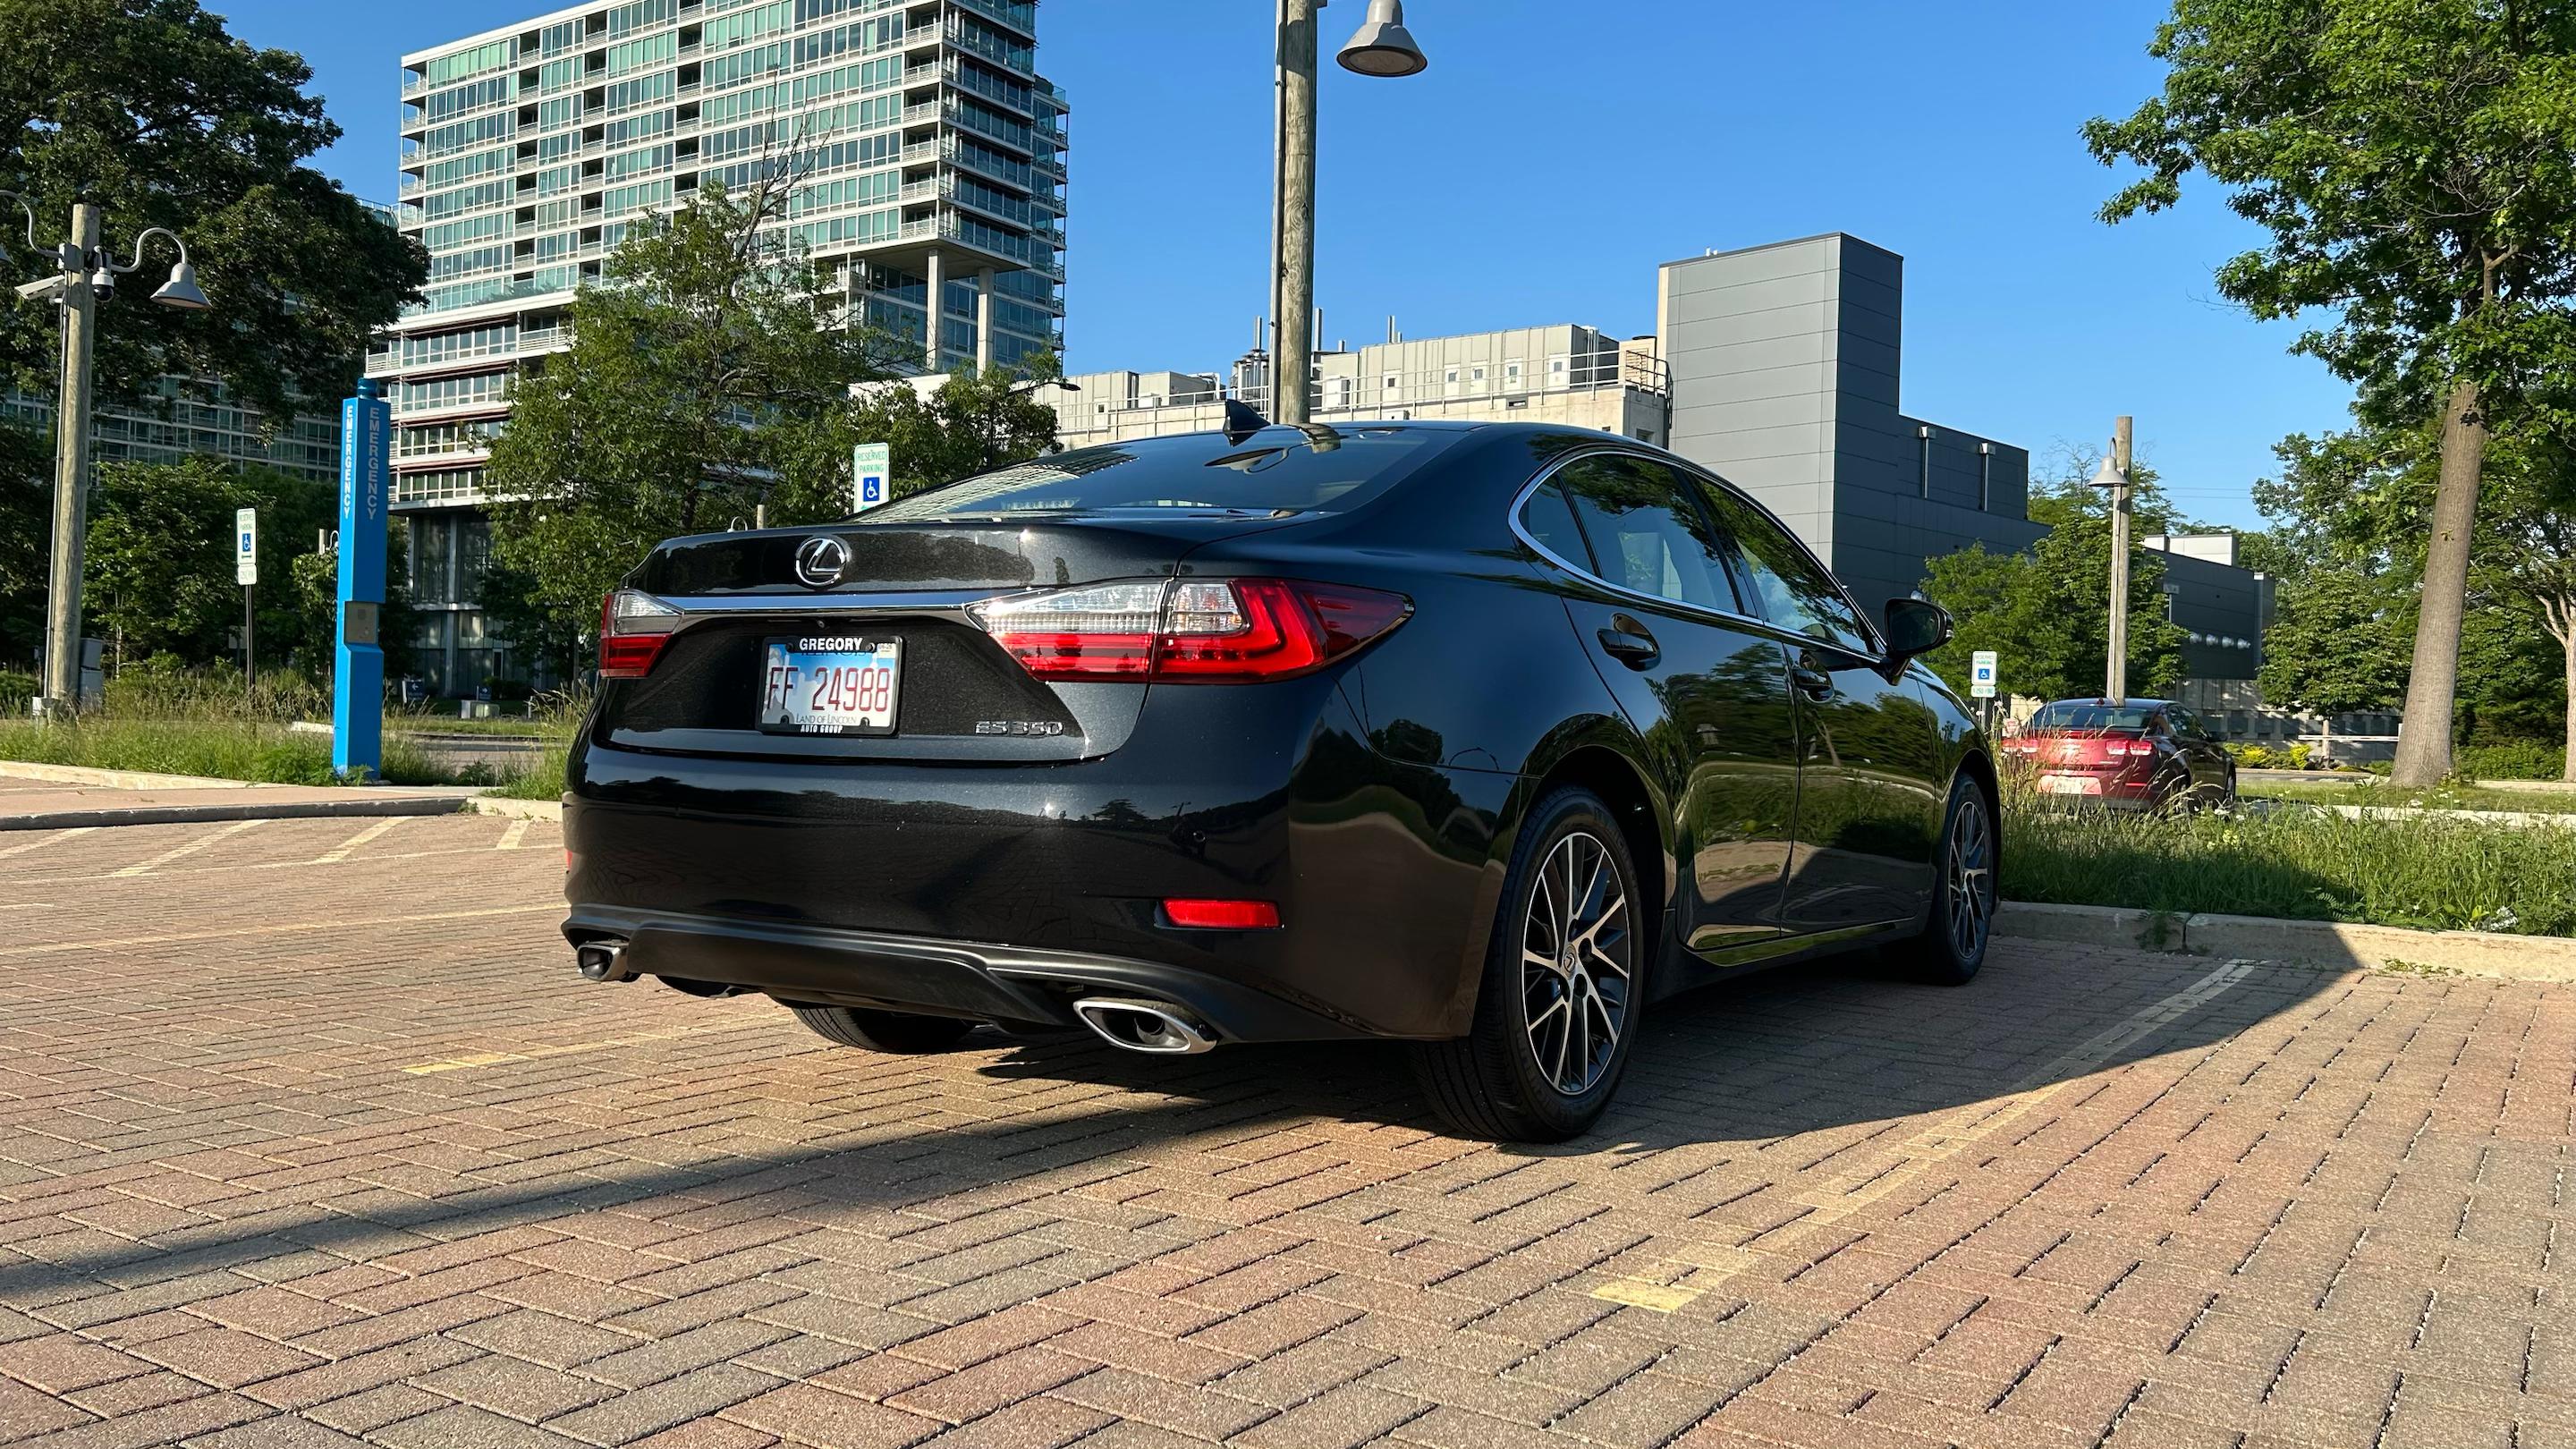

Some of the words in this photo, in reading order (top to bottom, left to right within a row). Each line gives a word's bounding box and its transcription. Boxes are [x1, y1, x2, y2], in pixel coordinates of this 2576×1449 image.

[343, 405, 353, 520] EMERGENCY
[858, 451, 886, 462] RESERVED
[367, 407, 380, 521] EMERGENCY
[859, 463, 884, 474] PARKING
[799, 638, 863, 651] GREGORY
[767, 666, 799, 709] FF
[811, 667, 891, 712] 24988
[796, 713, 816, 724] LAND
[817, 715, 826, 724] OF
[826, 714, 857, 724] LINCOLN
[800, 724, 818, 733] AUTO
[819, 725, 843, 733] GROUP
[975, 721, 1008, 733] ES
[1012, 721, 1063, 734] 350
